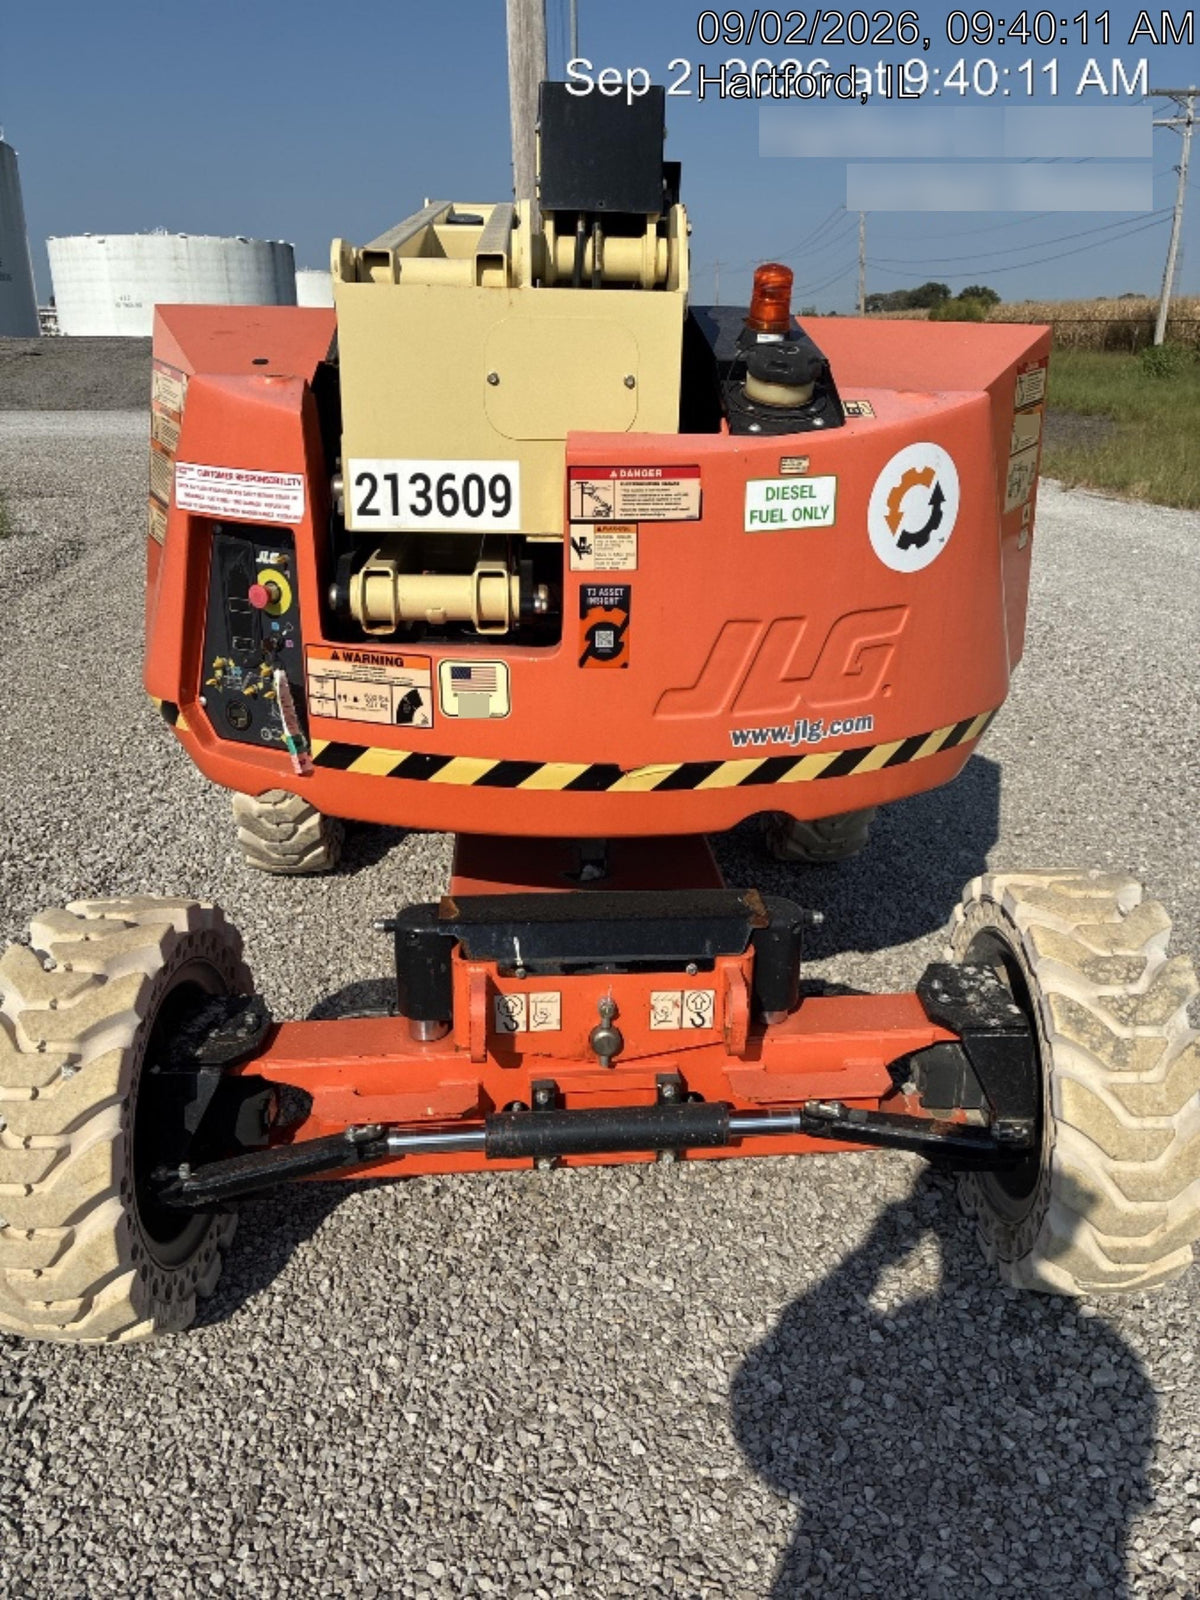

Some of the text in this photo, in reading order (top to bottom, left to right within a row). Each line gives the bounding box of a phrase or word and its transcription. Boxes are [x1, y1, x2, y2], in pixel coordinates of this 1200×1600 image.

[619, 468, 662, 478] DANGER
[355, 472, 512, 518] 213609
[765, 485, 817, 502] DIESEL
[749, 504, 830, 526] FUEL ONLY
[598, 588, 624, 597] ASSET
[342, 651, 404, 667] WARNING
[653, 604, 910, 720] JLG
[731, 715, 873, 746] www.jlg.com
